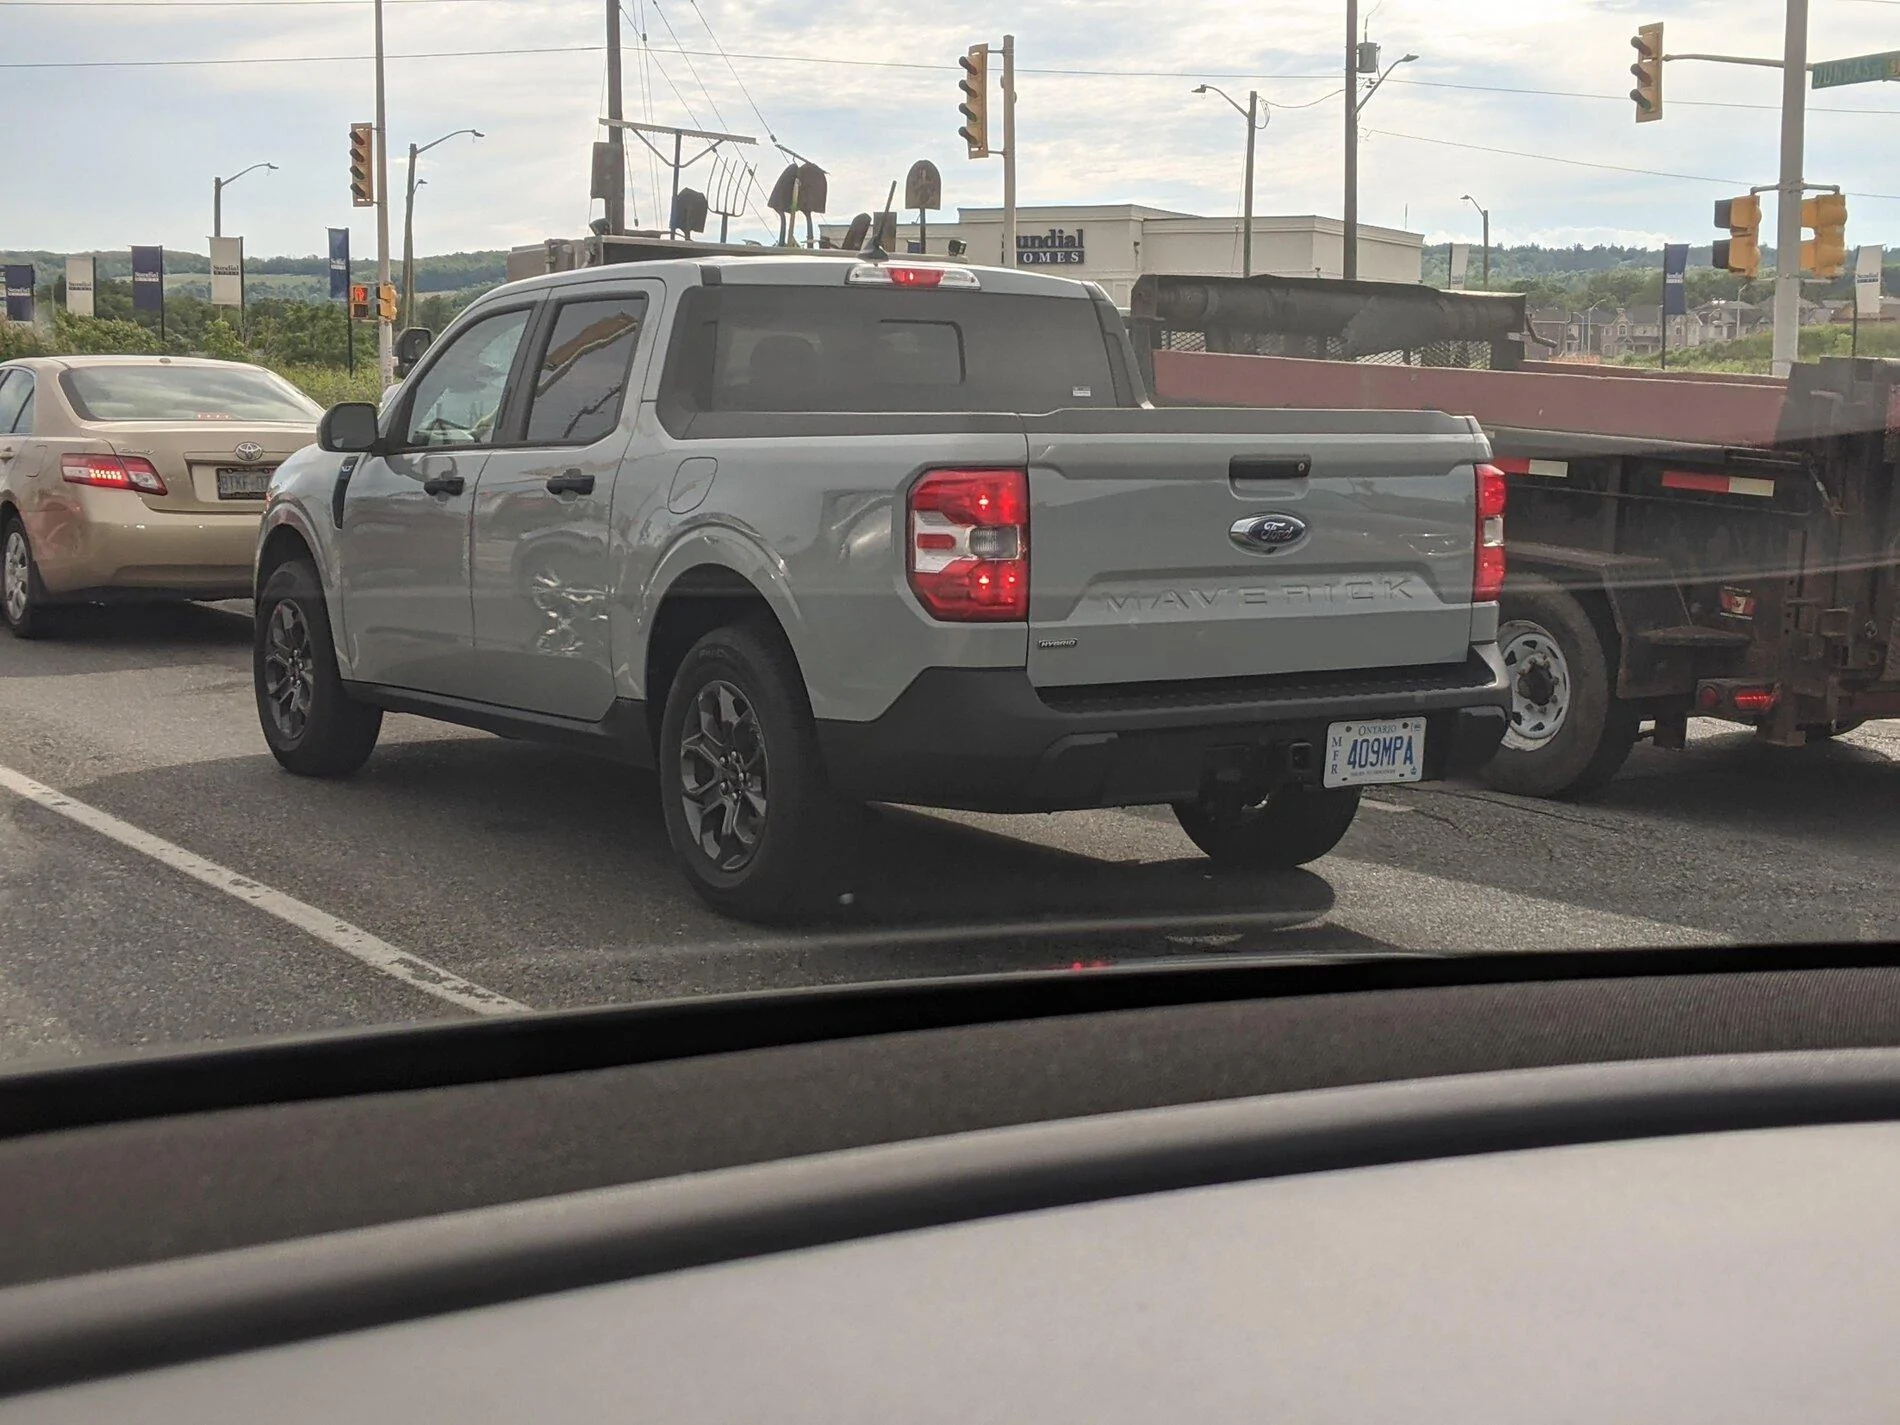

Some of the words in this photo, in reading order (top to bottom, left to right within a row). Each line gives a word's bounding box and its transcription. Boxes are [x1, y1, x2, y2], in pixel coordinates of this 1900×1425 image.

[1016, 228, 1085, 248] undial
[1261, 521, 1293, 540] Ford
[1101, 579, 1413, 612] MAVERICK
[1358, 724, 1397, 736] ONTARIO
[1347, 735, 1414, 769] 409MPA
